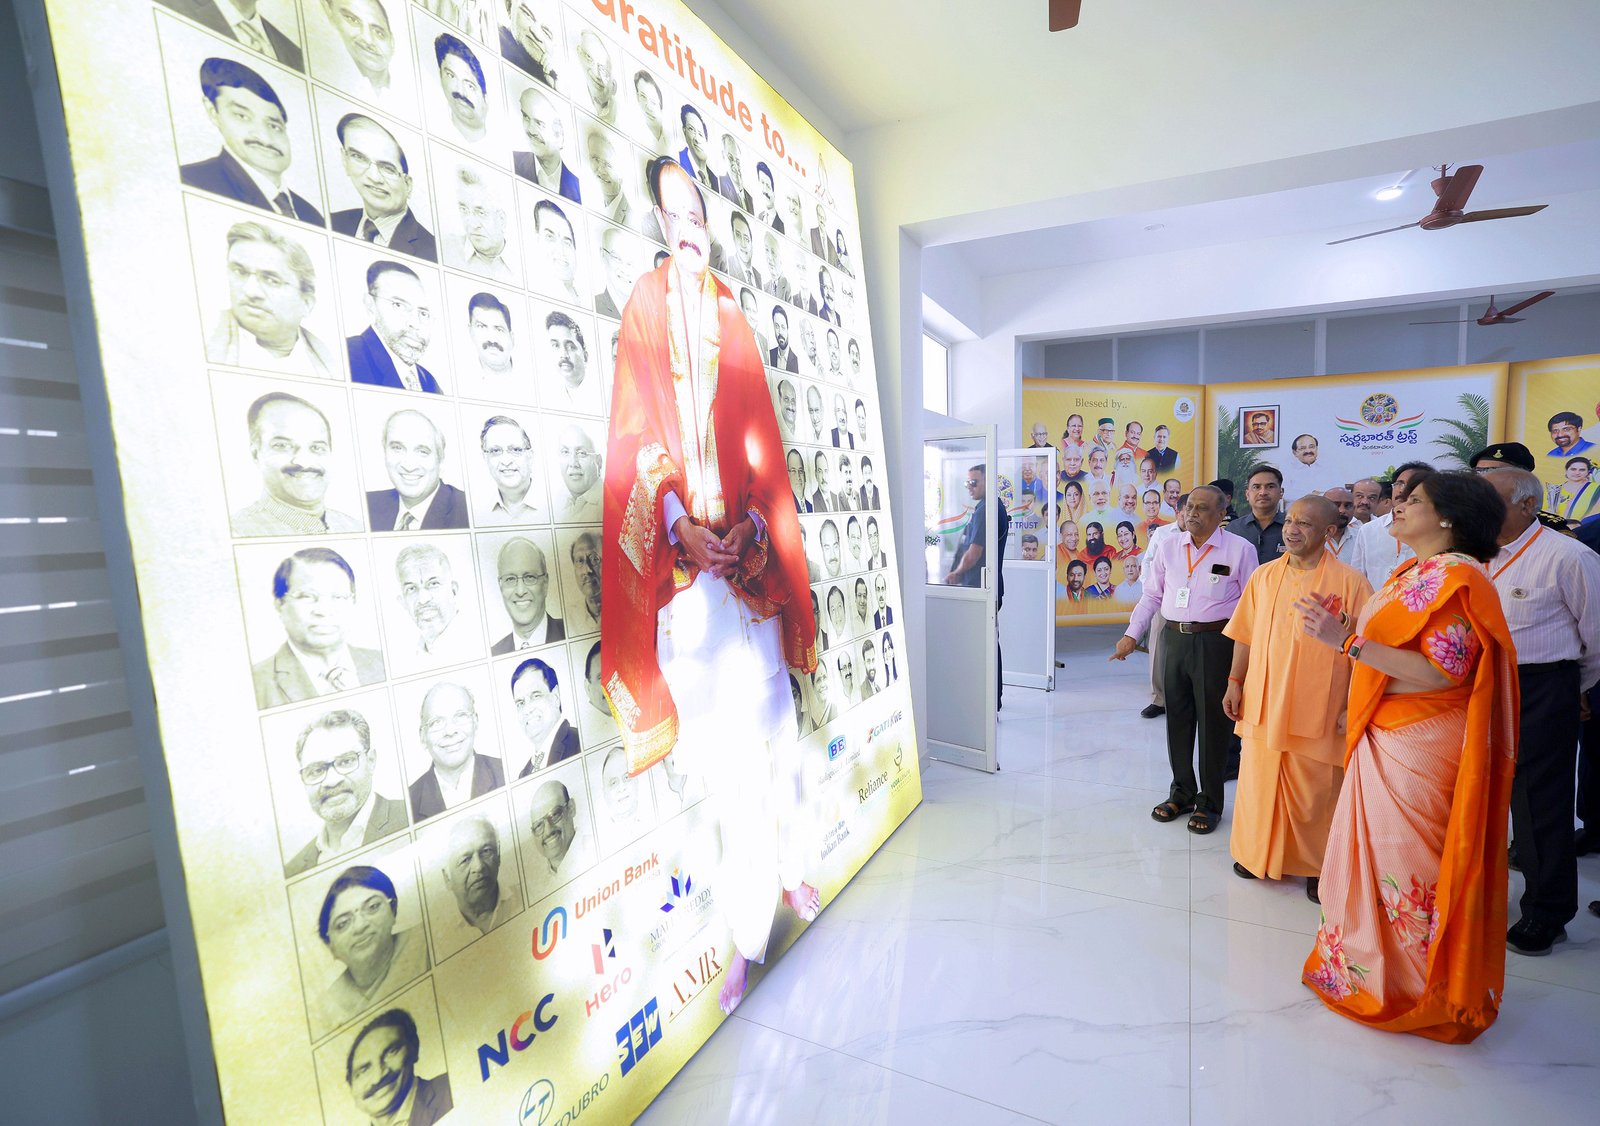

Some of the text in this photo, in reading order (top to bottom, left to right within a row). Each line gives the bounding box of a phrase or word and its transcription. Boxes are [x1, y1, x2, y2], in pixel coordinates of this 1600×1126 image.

[1075, 398, 1108, 408] Blessed
[1015, 521, 1038, 529] TRUST
[830, 739, 844, 757] BE
[858, 771, 888, 804] Reliance
[575, 852, 659, 919] Union Bank
[477, 993, 558, 1082] NCC
[617, 1010, 660, 1063] SEW
